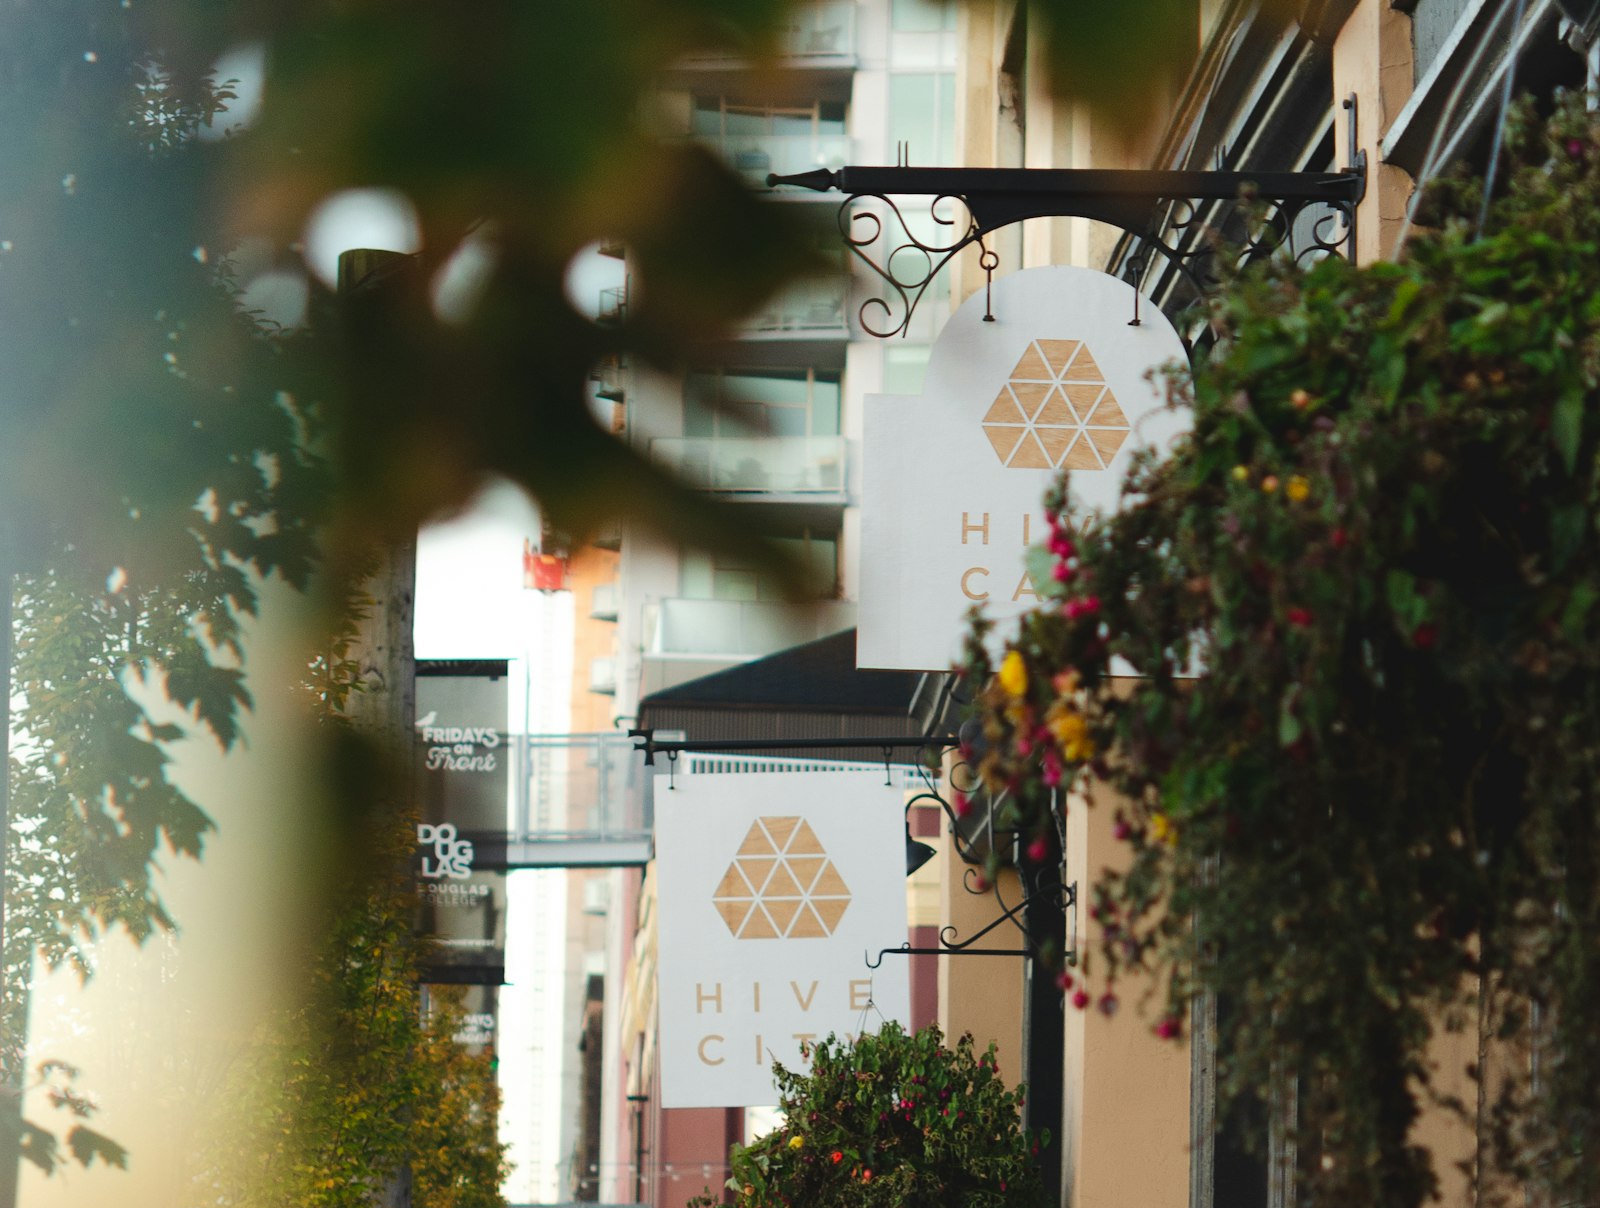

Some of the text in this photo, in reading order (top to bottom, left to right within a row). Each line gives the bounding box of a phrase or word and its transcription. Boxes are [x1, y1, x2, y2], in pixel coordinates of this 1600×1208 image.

[961, 511, 1094, 546] HIV
[422, 727, 500, 748] FRIDAYS
[453, 744, 474, 755] ON
[425, 746, 497, 771] Front
[695, 979, 877, 1014] HIVE
